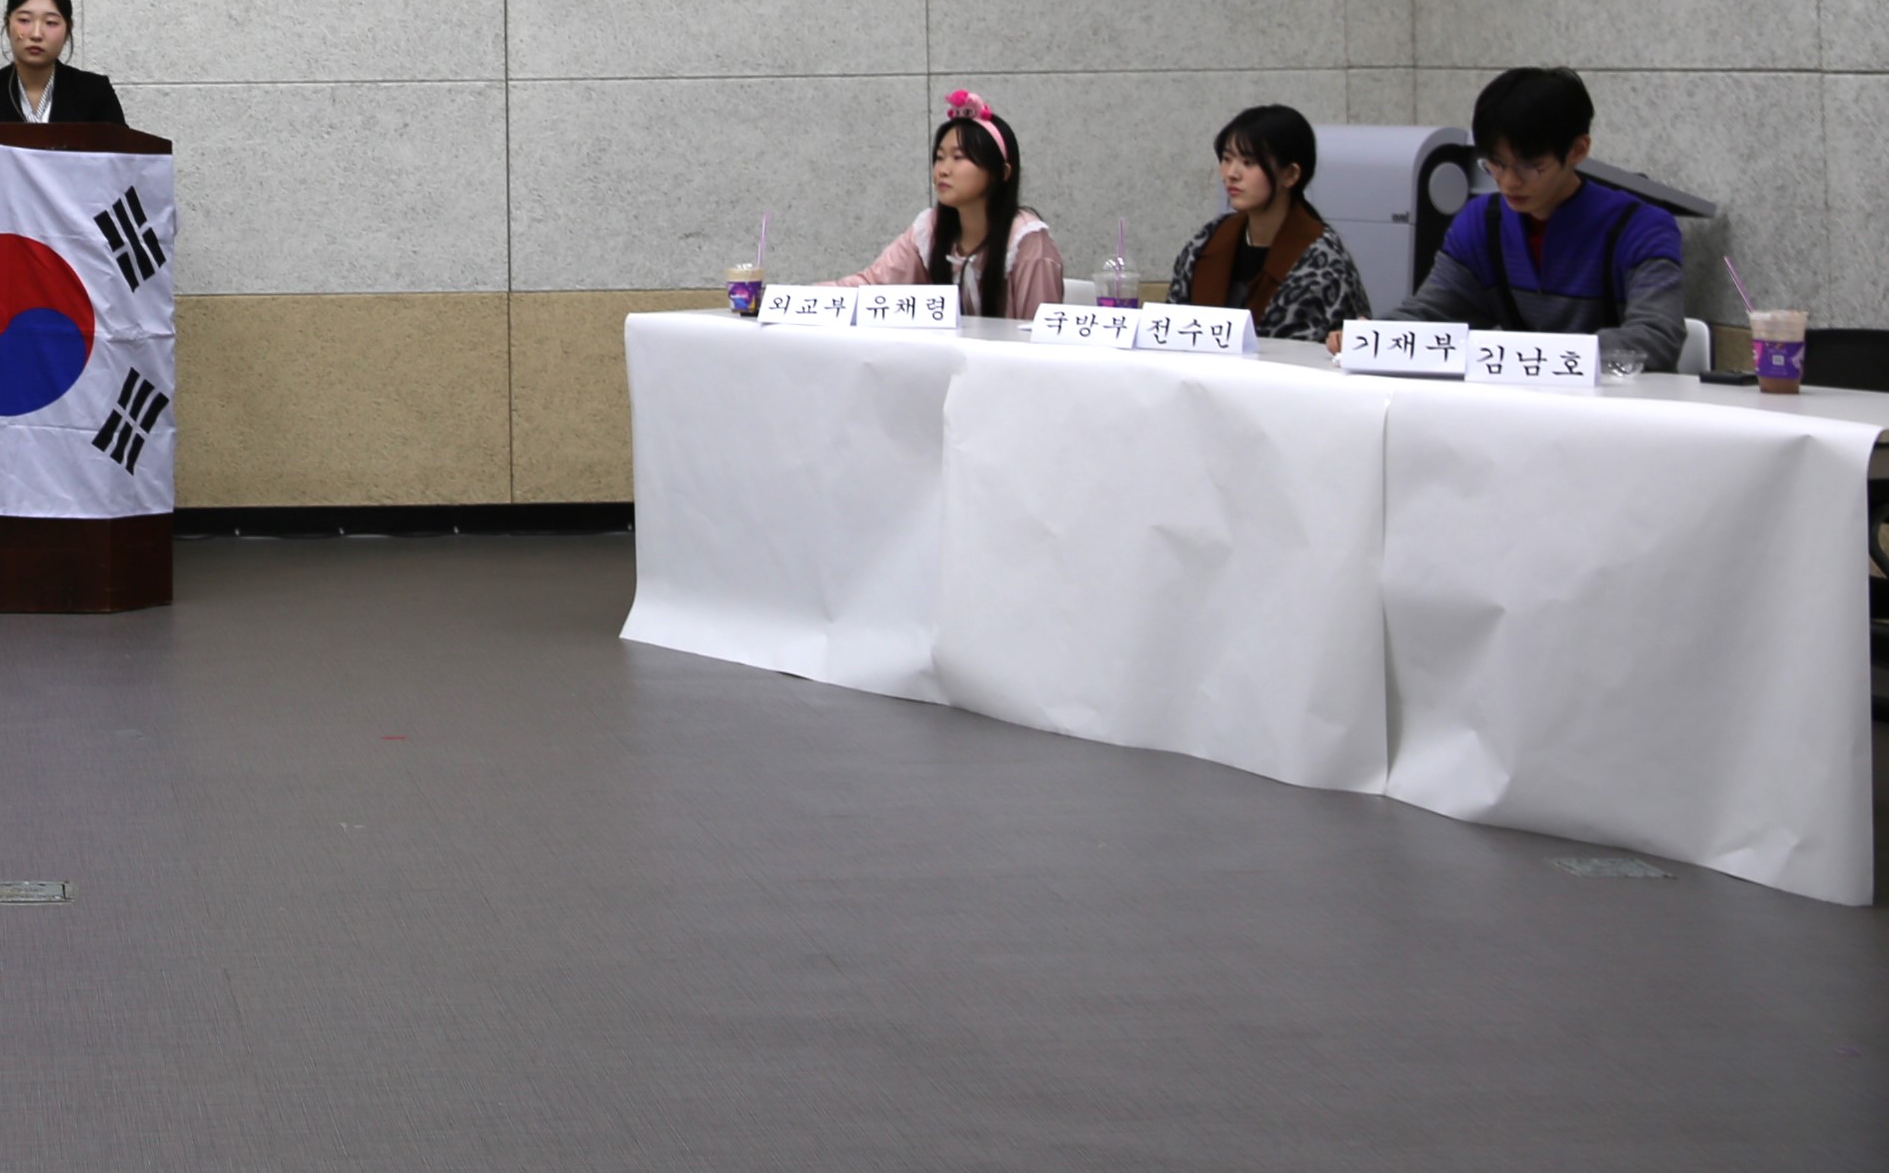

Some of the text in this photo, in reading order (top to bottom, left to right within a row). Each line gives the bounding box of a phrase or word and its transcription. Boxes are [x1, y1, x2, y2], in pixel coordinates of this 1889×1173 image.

[767, 294, 946, 322] 외교부 유채령
[1043, 310, 1233, 349] 국방부 전수민
[1352, 330, 1585, 378] 기재부 김남호
